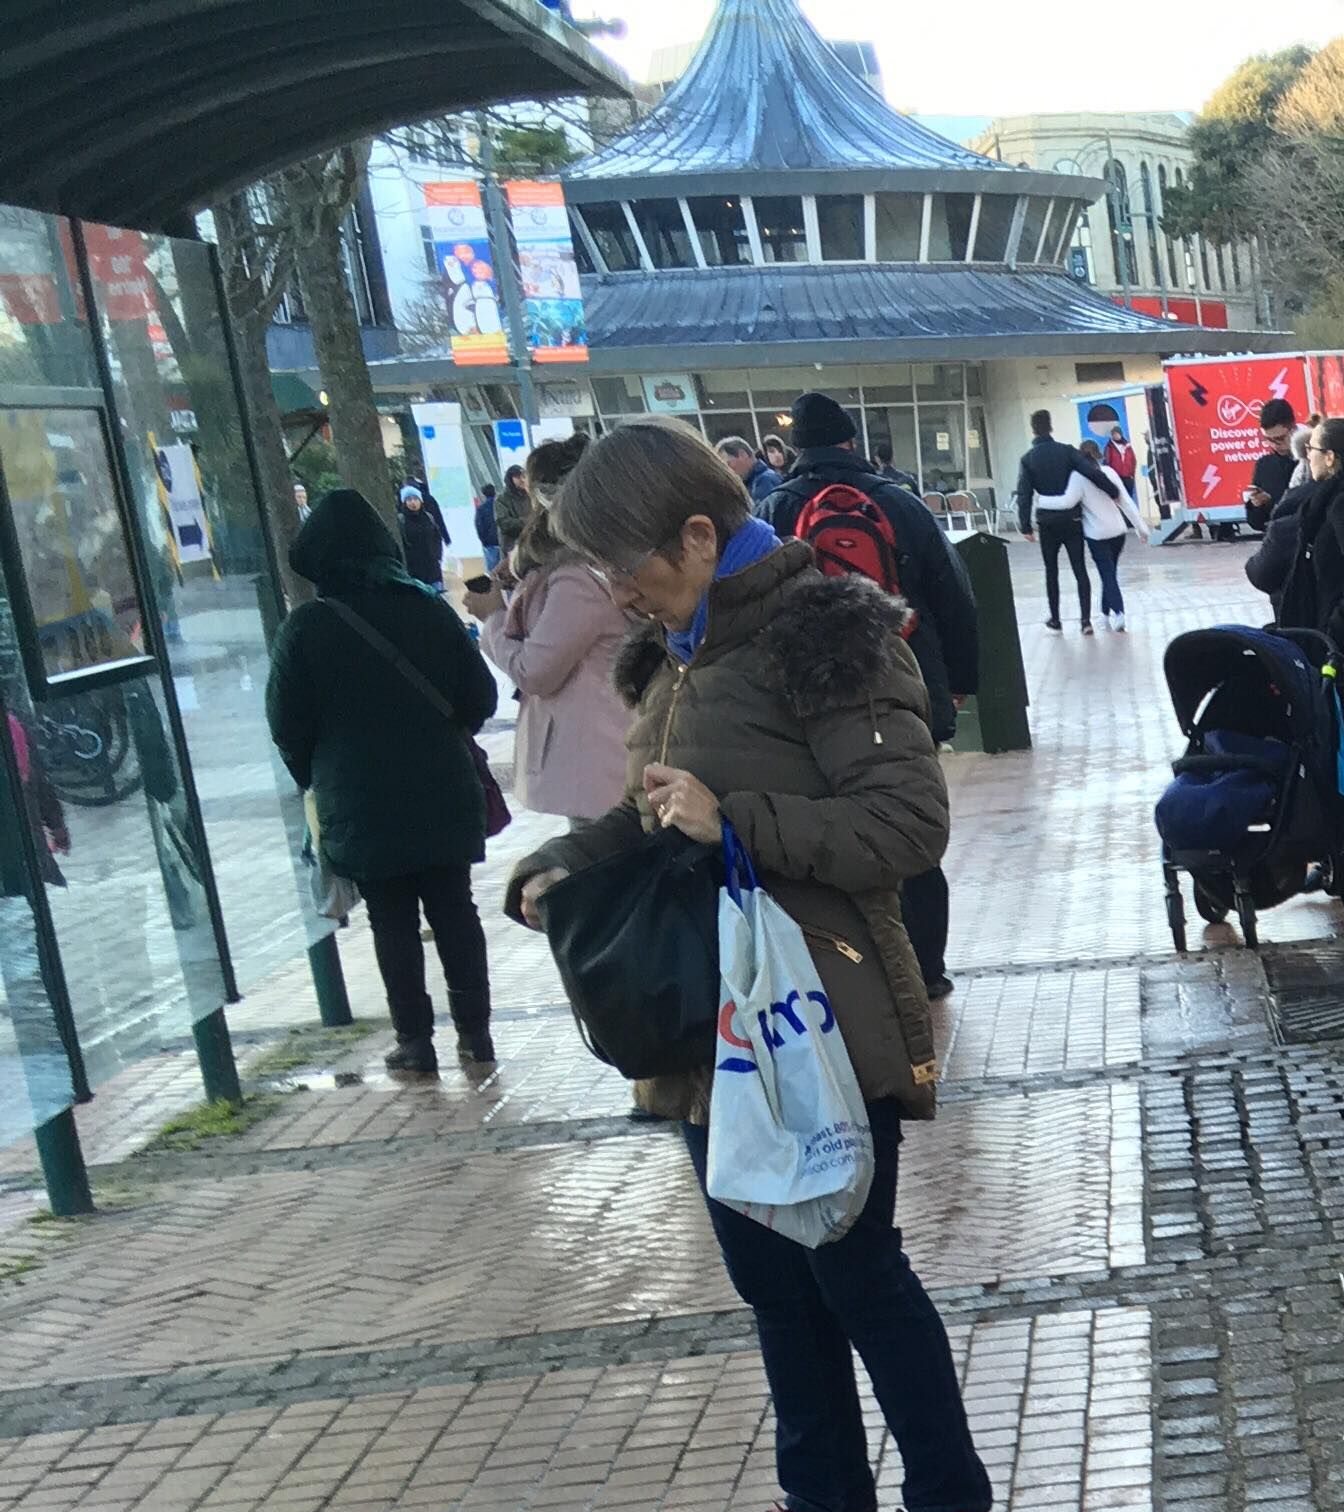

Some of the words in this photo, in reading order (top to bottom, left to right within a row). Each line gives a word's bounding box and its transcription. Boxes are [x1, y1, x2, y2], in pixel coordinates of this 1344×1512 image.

[1210, 427, 1259, 439] Discover
[1210, 440, 1246, 453] power
[1247, 438, 1260, 448] of
[822, 1138, 843, 1154] old
